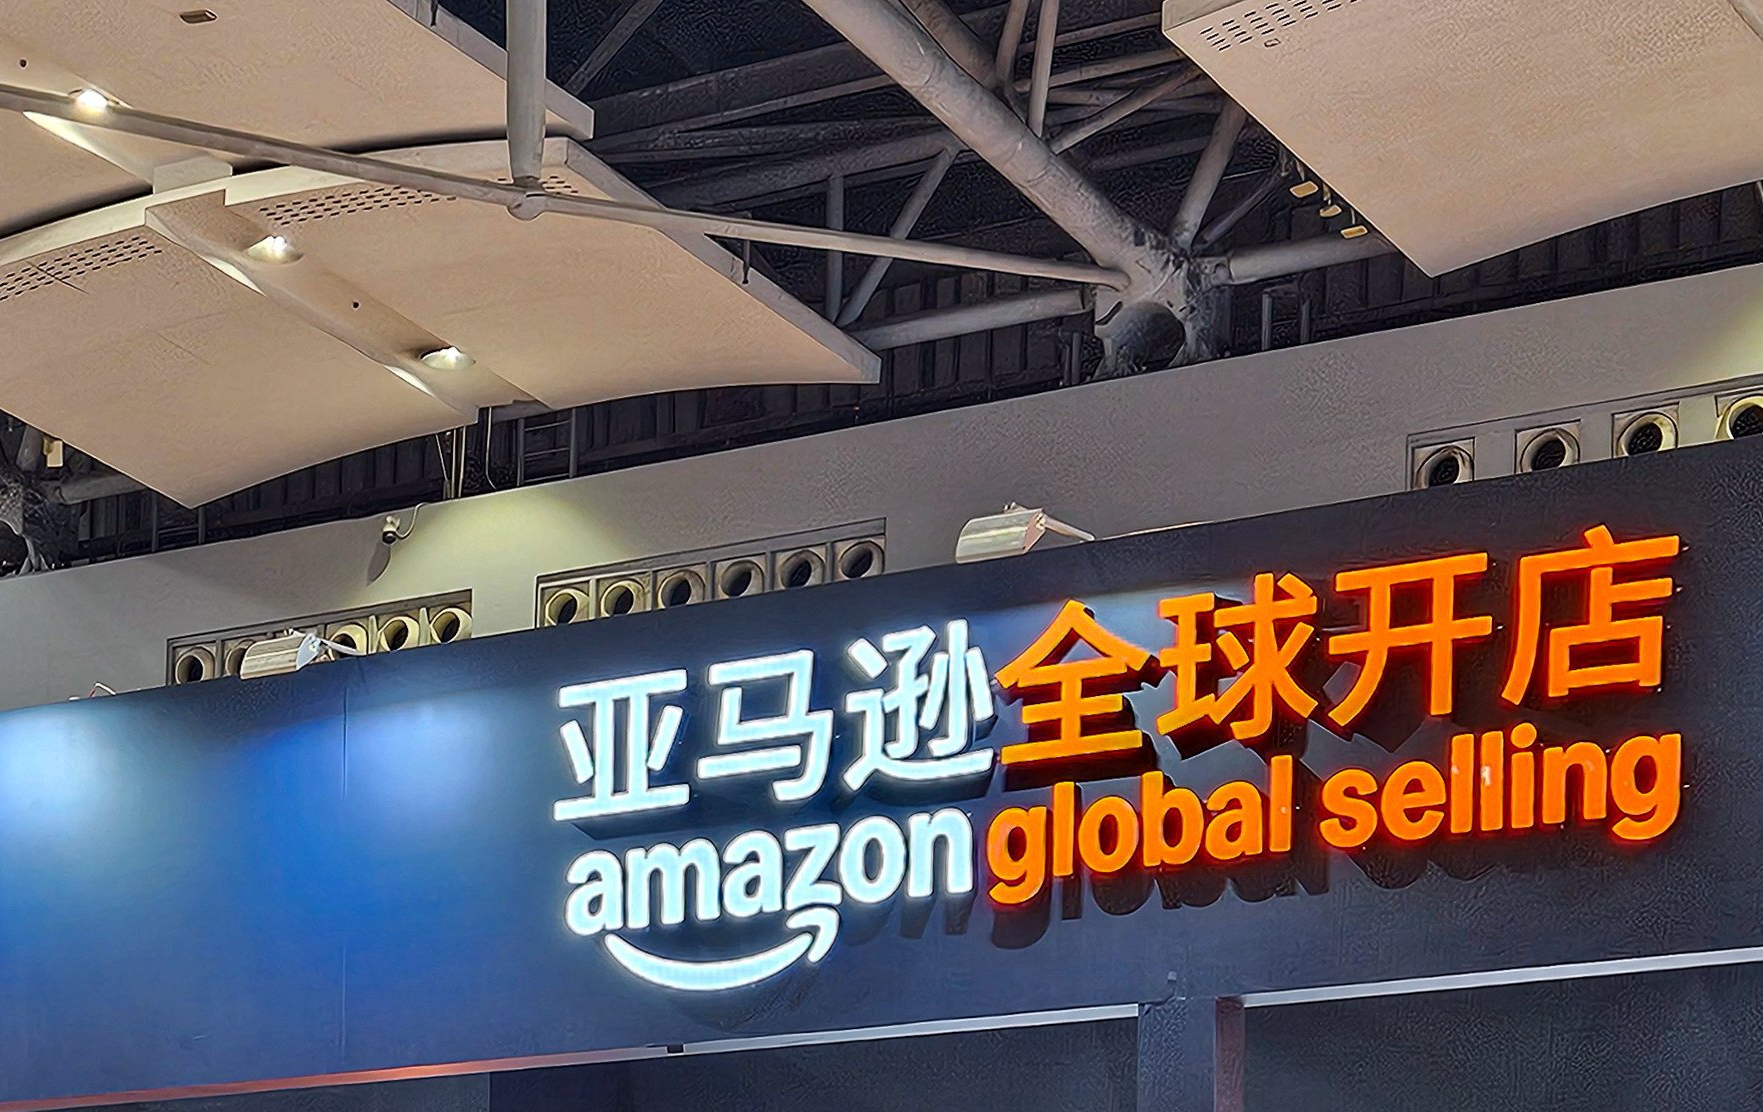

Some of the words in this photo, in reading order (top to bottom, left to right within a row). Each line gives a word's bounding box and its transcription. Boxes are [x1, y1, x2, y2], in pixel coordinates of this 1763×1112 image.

[551, 523, 1684, 824] 亚马逊全球开店
[563, 806, 975, 945] amazon
[984, 754, 1297, 908] global
[1317, 720, 1684, 846] selling
